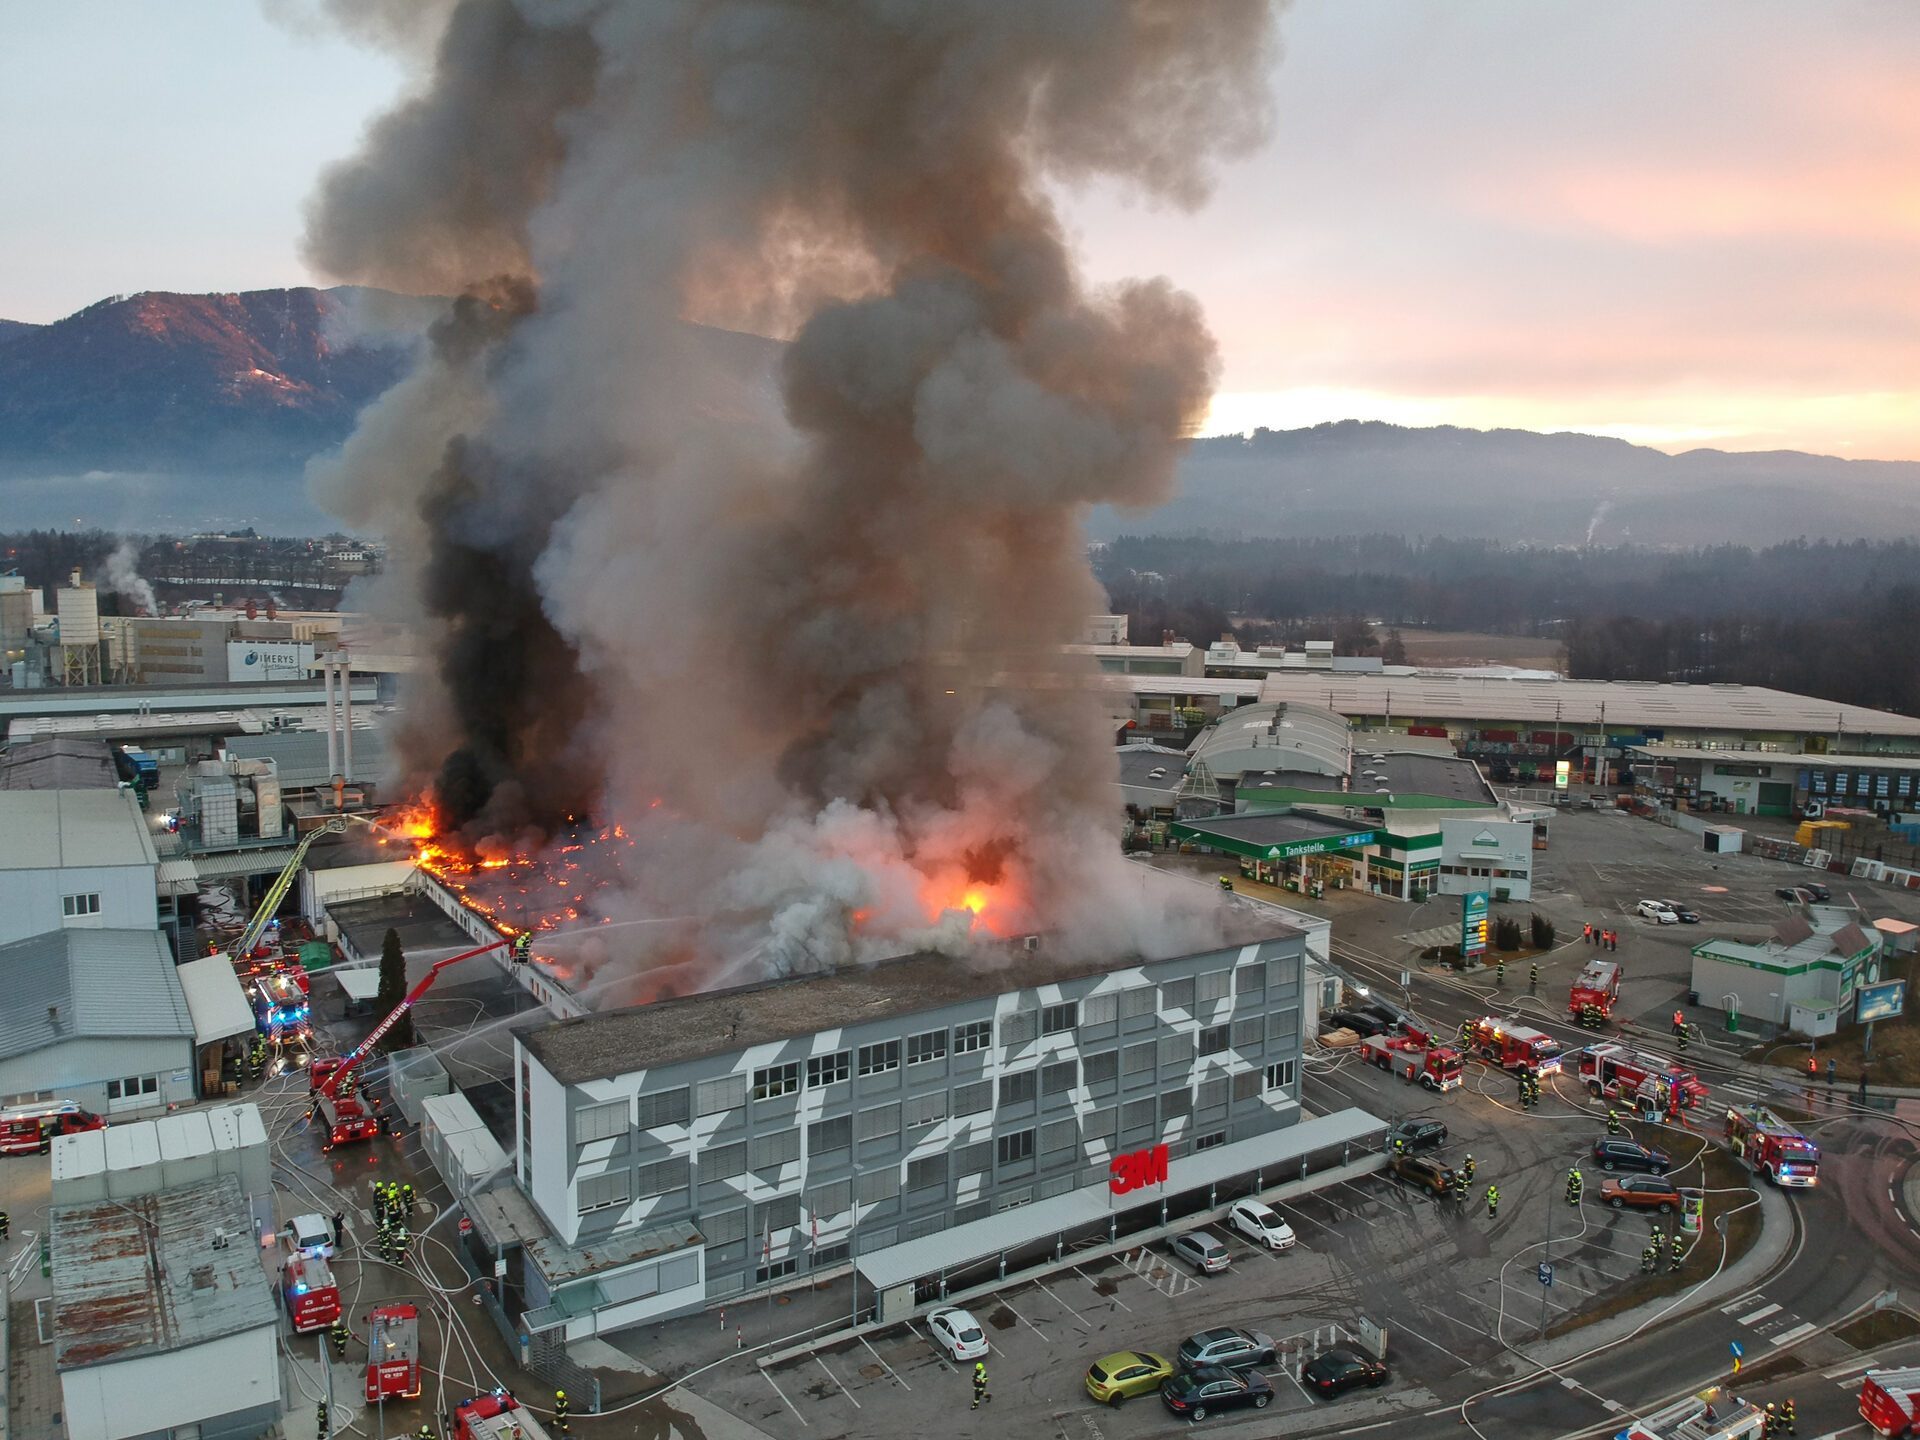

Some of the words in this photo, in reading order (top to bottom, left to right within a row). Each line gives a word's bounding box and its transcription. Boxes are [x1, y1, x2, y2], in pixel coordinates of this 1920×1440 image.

[260, 654, 295, 664] IMERYS
[1285, 842, 1325, 857] Tankstelle
[358, 1002, 410, 1055] FEUERWEHR
[1108, 1143, 1169, 1196] 3M
